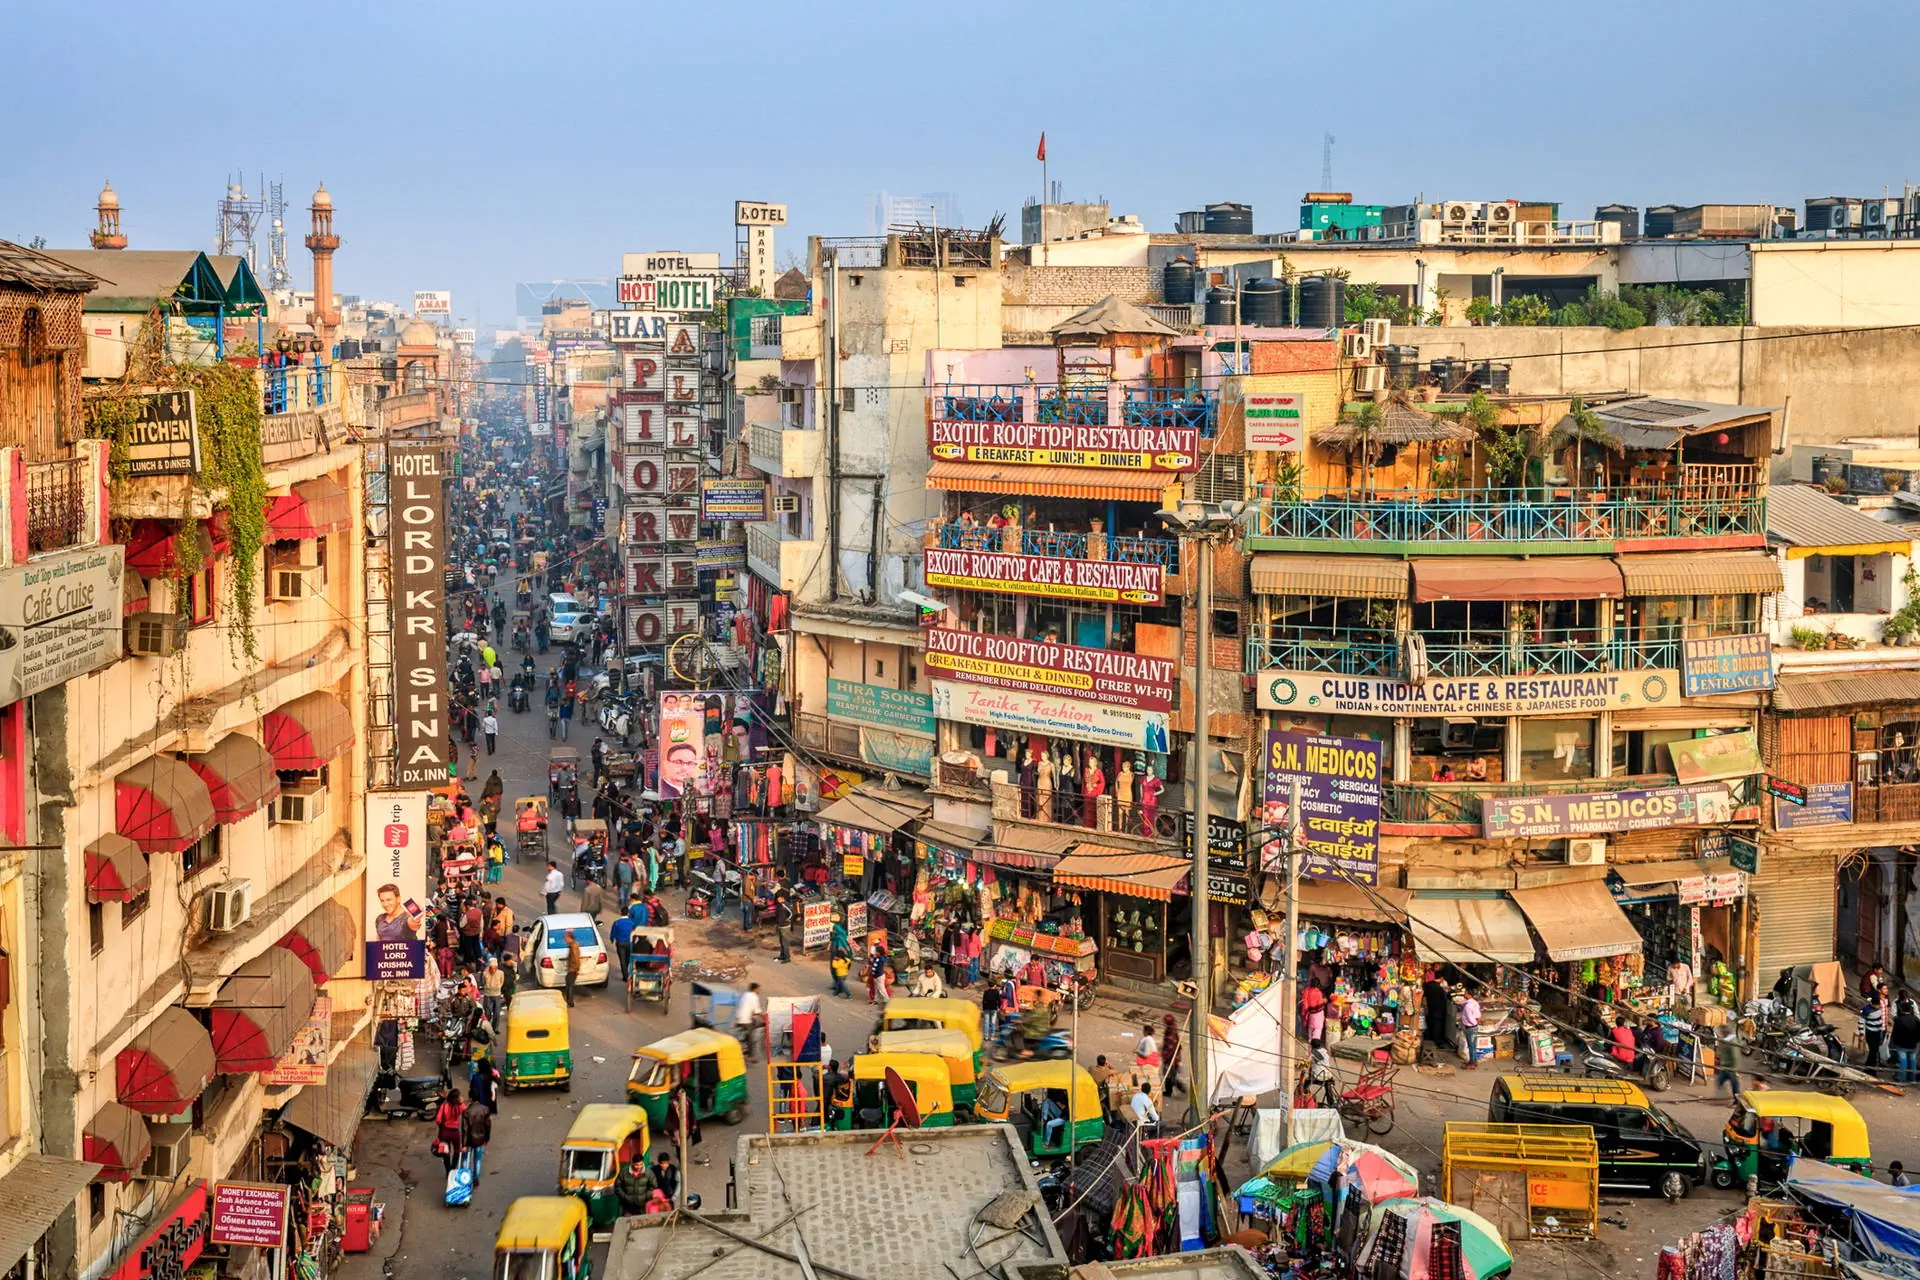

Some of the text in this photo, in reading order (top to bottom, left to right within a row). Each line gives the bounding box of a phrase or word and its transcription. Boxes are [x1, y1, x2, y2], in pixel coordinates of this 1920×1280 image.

[647, 258, 692, 270] HOTEL
[657, 281, 712, 309] HOTEL
[1246, 408, 1300, 418] CLUB INDIA
[932, 421, 1195, 452] EXOTIC ROOFTOP RESTAURANT
[132, 458, 191, 472] LUNCH & DINNER
[394, 455, 440, 476] HOTEL
[975, 447, 1142, 467] BREAKFAST LUNCH DINNER
[24, 570, 40, 586] Roof
[52, 565, 66, 579] with
[87, 555, 107, 569] Garden
[927, 551, 1159, 592] EXOTIC ROOFTOP CAFE & RESTAURANT
[23, 581, 94, 625] Café Cruise
[402, 481, 440, 765] LORD KRISHNA
[928, 629, 1174, 683] EXOTIC ROOFTOP RESTAURANT
[1686, 636, 1767, 659] BREAKFAST
[1688, 655, 1769, 675] LUNCH & DINNER
[929, 653, 1173, 702] BREAKFAST LUNCH & DINNER (FREE WI-FI)
[1701, 674, 1760, 690] ENTRANCE
[836, 682, 926, 707] HIRA SONS
[955, 671, 1138, 706] REMEMBER US FOR DELICIOUS FOOD SERVICES
[1322, 677, 1619, 701] CLUB INDIA CAFE & RESTAURANT
[835, 701, 859, 710] READY
[861, 706, 882, 715] MADE
[884, 710, 926, 723] GARMENTS
[968, 690, 1094, 722] Tanika Fashion
[1336, 698, 1607, 713] INDIAN CONTINENTAL CHINESE & JAPANESE FOOD
[1047, 718, 1076, 730] Garments
[1092, 725, 1110, 734] Dance
[1111, 728, 1133, 738] Dresses
[1272, 742, 1377, 781] S.N. MEDICOS
[1276, 773, 1313, 786] CHEMIST
[1339, 780, 1379, 794] SERGICAL
[1301, 800, 1343, 815] COSMETIC
[1338, 793, 1378, 806] MEDICINE
[391, 804, 403, 823] trip
[1510, 795, 1677, 825] S.N. MEDICOS
[1520, 824, 1560, 836] CHEMIST
[1570, 820, 1620, 833] PHARMACY
[1628, 816, 1672, 829] COSMETIC
[391, 849, 401, 878] make
[383, 943, 409, 951] HOTEL
[385, 951, 407, 960] LORD
[378, 961, 413, 969] KRISHNA
[381, 970, 395, 978] DX.
[217, 1196, 283, 1208] Cash Advance Credit
[222, 1188, 280, 1199] MONEY EXCHANGE
[236, 1205, 252, 1213] Debit
[254, 1207, 270, 1215] Card
[221, 1215, 276, 1228] Обмен валюты
